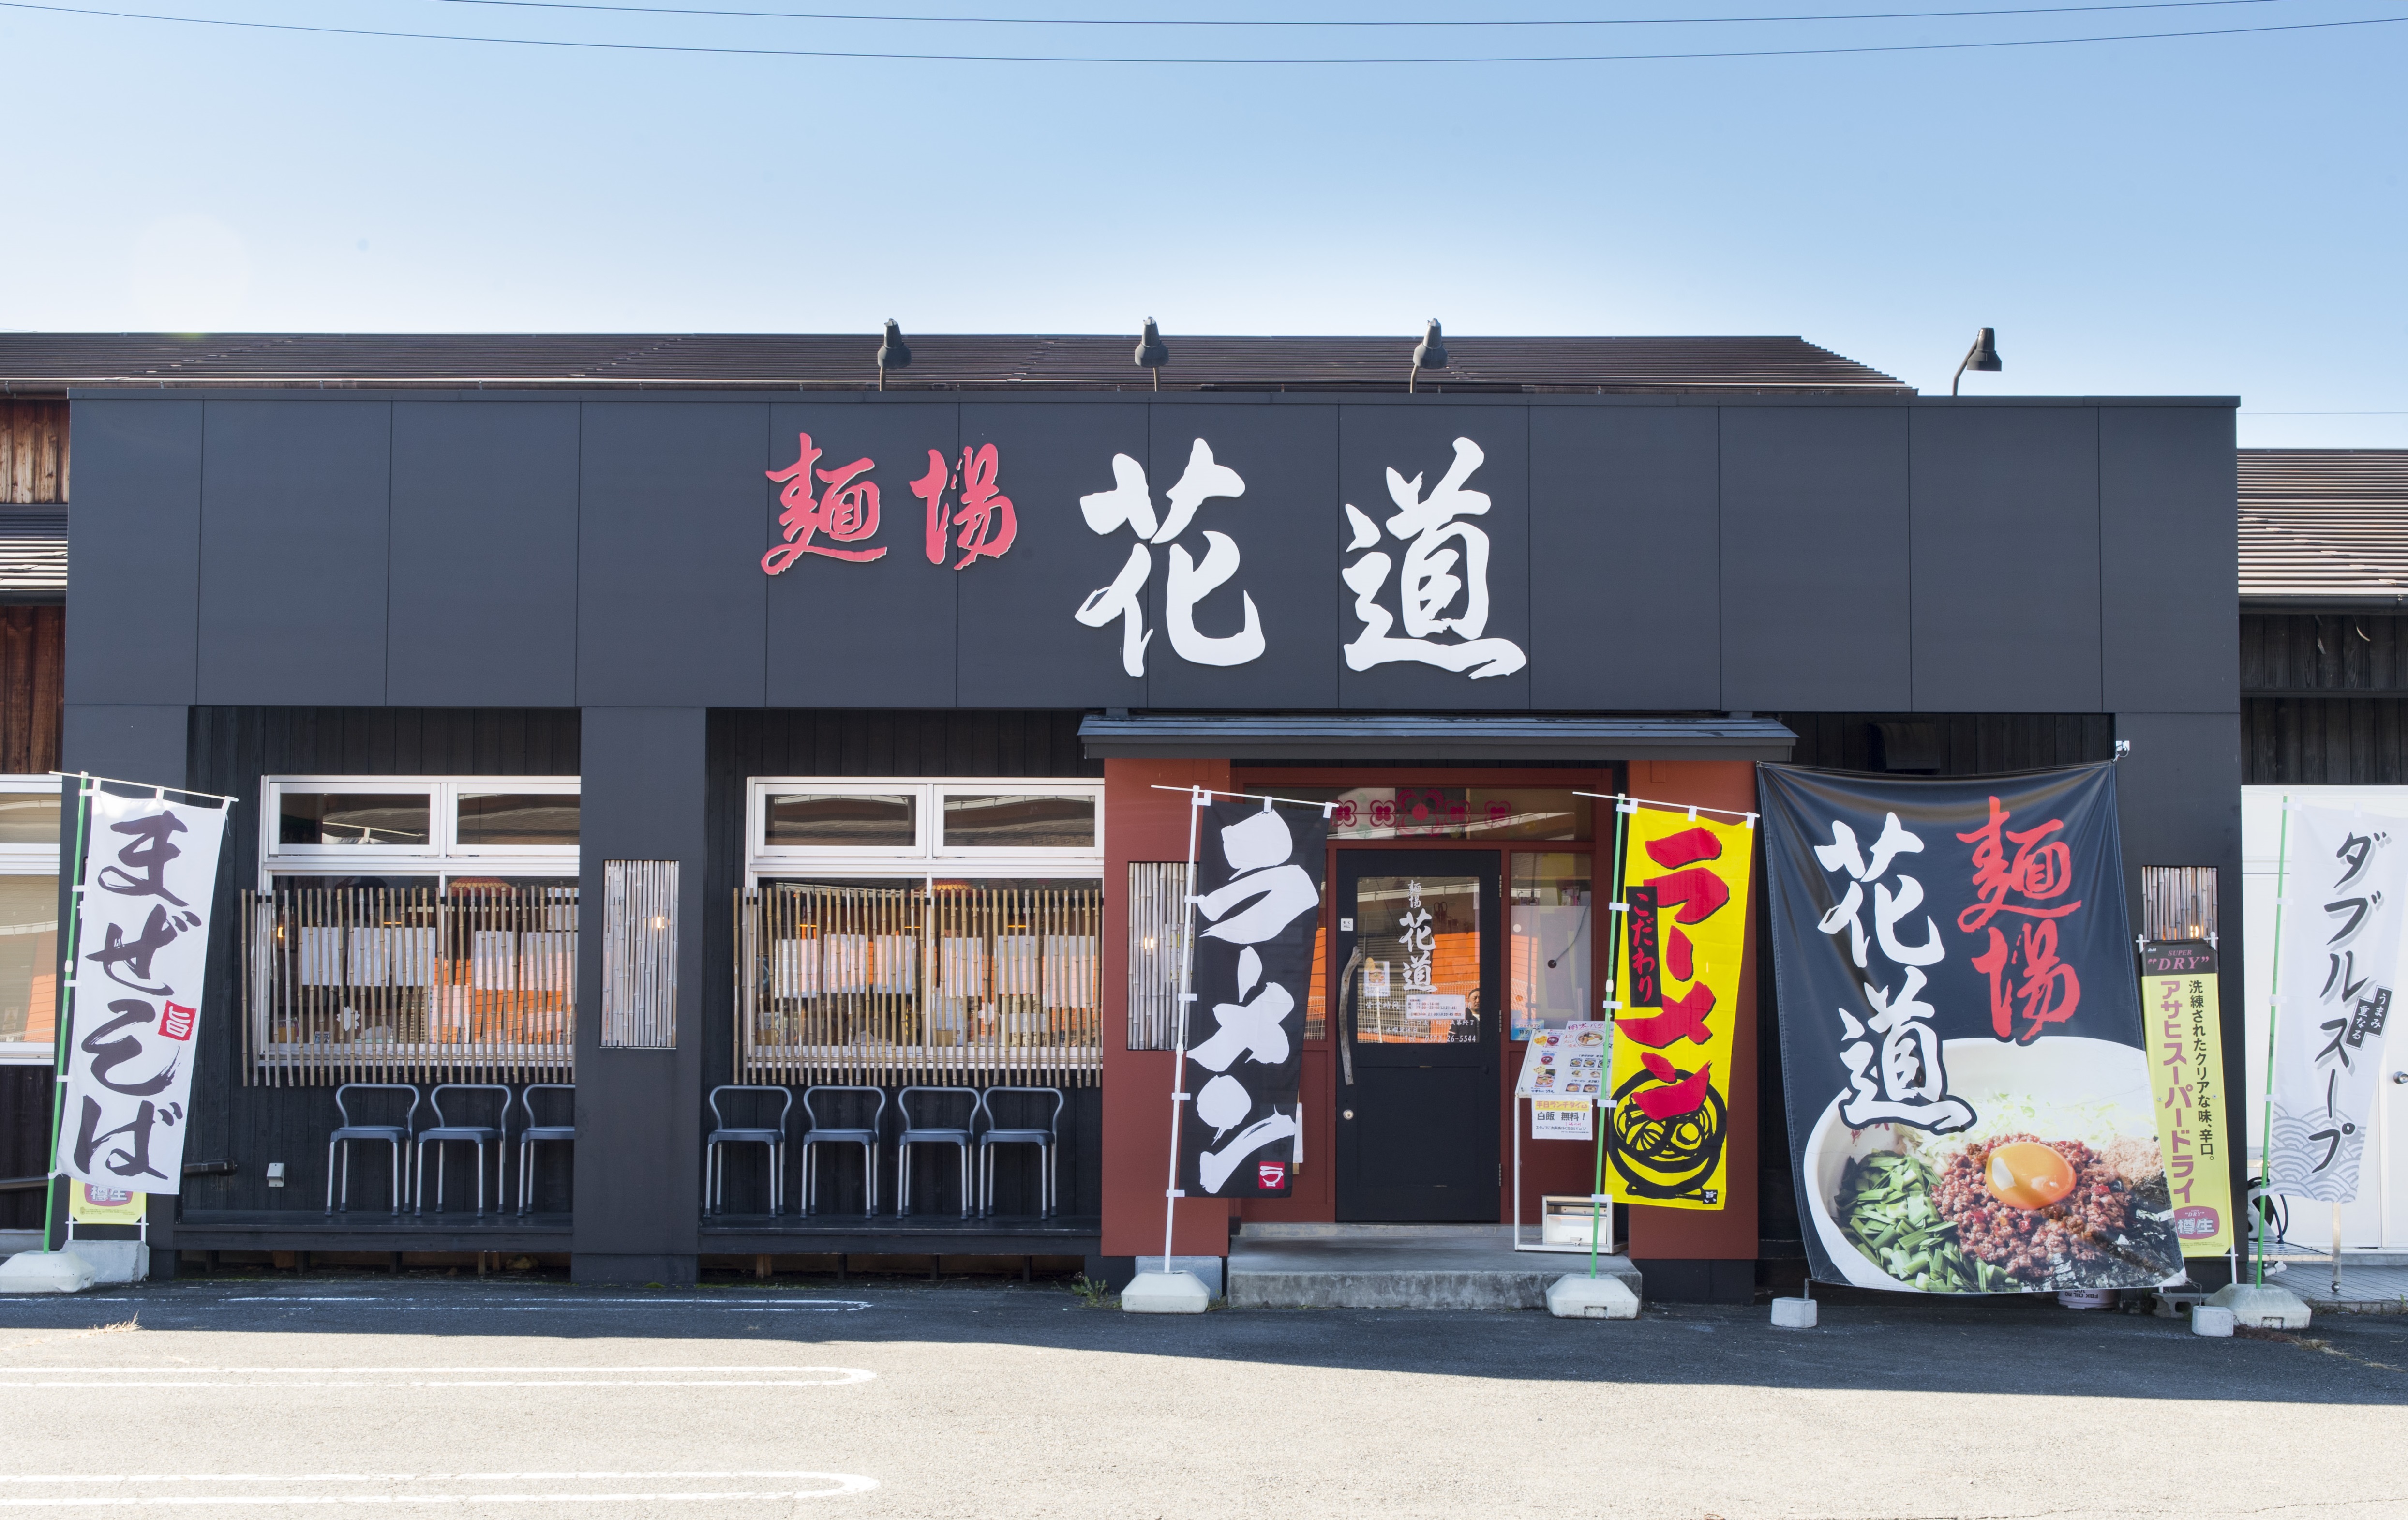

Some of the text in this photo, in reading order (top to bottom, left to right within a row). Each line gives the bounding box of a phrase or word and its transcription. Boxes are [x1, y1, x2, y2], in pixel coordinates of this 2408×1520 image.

[1074, 437, 1527, 679] 花道
[75, 810, 201, 1179] まぜそば
[1186, 809, 1319, 1194] ラーメン
[1398, 908, 1438, 992] 花道
[1615, 827, 1729, 1121] ラーメン
[1631, 893, 1655, 1002] こだわり
[1814, 812, 1973, 1130] 花道
[2308, 831, 2387, 1174] ダブルスープ
[2352, 1005, 2370, 1039] 重なる
[2370, 993, 2386, 1028] うまみ
[1537, 1112, 1555, 1120] 白飯
[2161, 980, 2194, 1203] アサヒスーパードライ
[2189, 980, 2214, 1160] 洗練されたクリアな味、辛口。
[2177, 1217, 2215, 1234] 樽生
